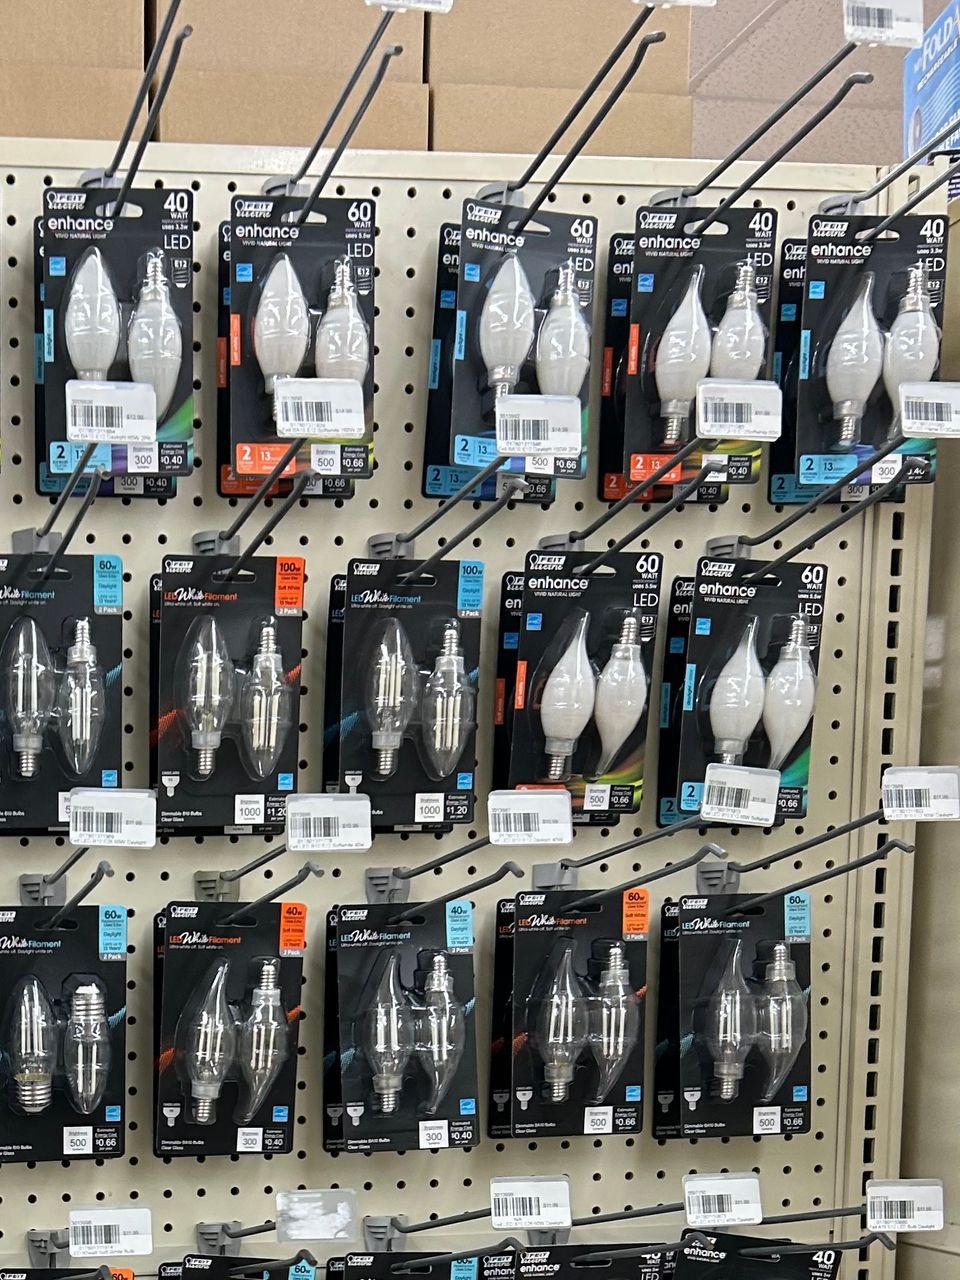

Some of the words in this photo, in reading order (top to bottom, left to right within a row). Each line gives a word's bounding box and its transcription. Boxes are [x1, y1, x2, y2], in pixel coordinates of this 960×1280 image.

[922, 16, 953, 72] FOLD
[164, 192, 188, 211] 40
[348, 202, 371, 221] 60
[48, 216, 114, 231] enhance
[749, 213, 772, 230] 40
[236, 224, 299, 238] enhance
[570, 219, 593, 238] 60
[920, 219, 944, 237] 40
[164, 235, 190, 249] LED
[466, 228, 525, 247] enhance
[640, 235, 700, 249] enhance
[348, 243, 373, 257] LED
[811, 243, 872, 256] enhance
[460, 439, 469, 451] 2
[478, 445, 487, 453] 13
[56, 446, 65, 458] 2
[242, 446, 251, 460] 2
[260, 452, 271, 461] 13
[135, 455, 152, 465] 300
[161, 455, 182, 465] $0.40
[318, 458, 334, 467] 500
[342, 459, 364, 469] $0.66
[532, 458, 548, 466] 500
[556, 460, 576, 469] $0.66
[636, 457, 643, 469] 2
[806, 458, 814, 471] 2
[879, 466, 895, 476] 300
[100, 561, 117, 570] 60w
[279, 562, 300, 572] 100w
[636, 554, 659, 573] 60
[801, 566, 824, 584] 60
[528, 575, 588, 590] enhance
[21, 591, 55, 599] Filament
[699, 583, 757, 598] enhance
[634, 593, 658, 607] LED
[799, 602, 823, 616] LED
[687, 785, 695, 797] 2
[611, 796, 629, 804] $0.66
[420, 806, 440, 815] 1000
[447, 806, 467, 815] $1.20
[104, 910, 122, 920] 60w
[286, 906, 302, 916] 40w
[341, 933, 352, 942] LED
[351, 929, 379, 942] White
[379, 932, 411, 940] Filament
[69, 1138, 87, 1147] 500
[95, 1138, 117, 1147] $0.66
[683, 1248, 727, 1260] enhance
[812, 1250, 835, 1265] 40
